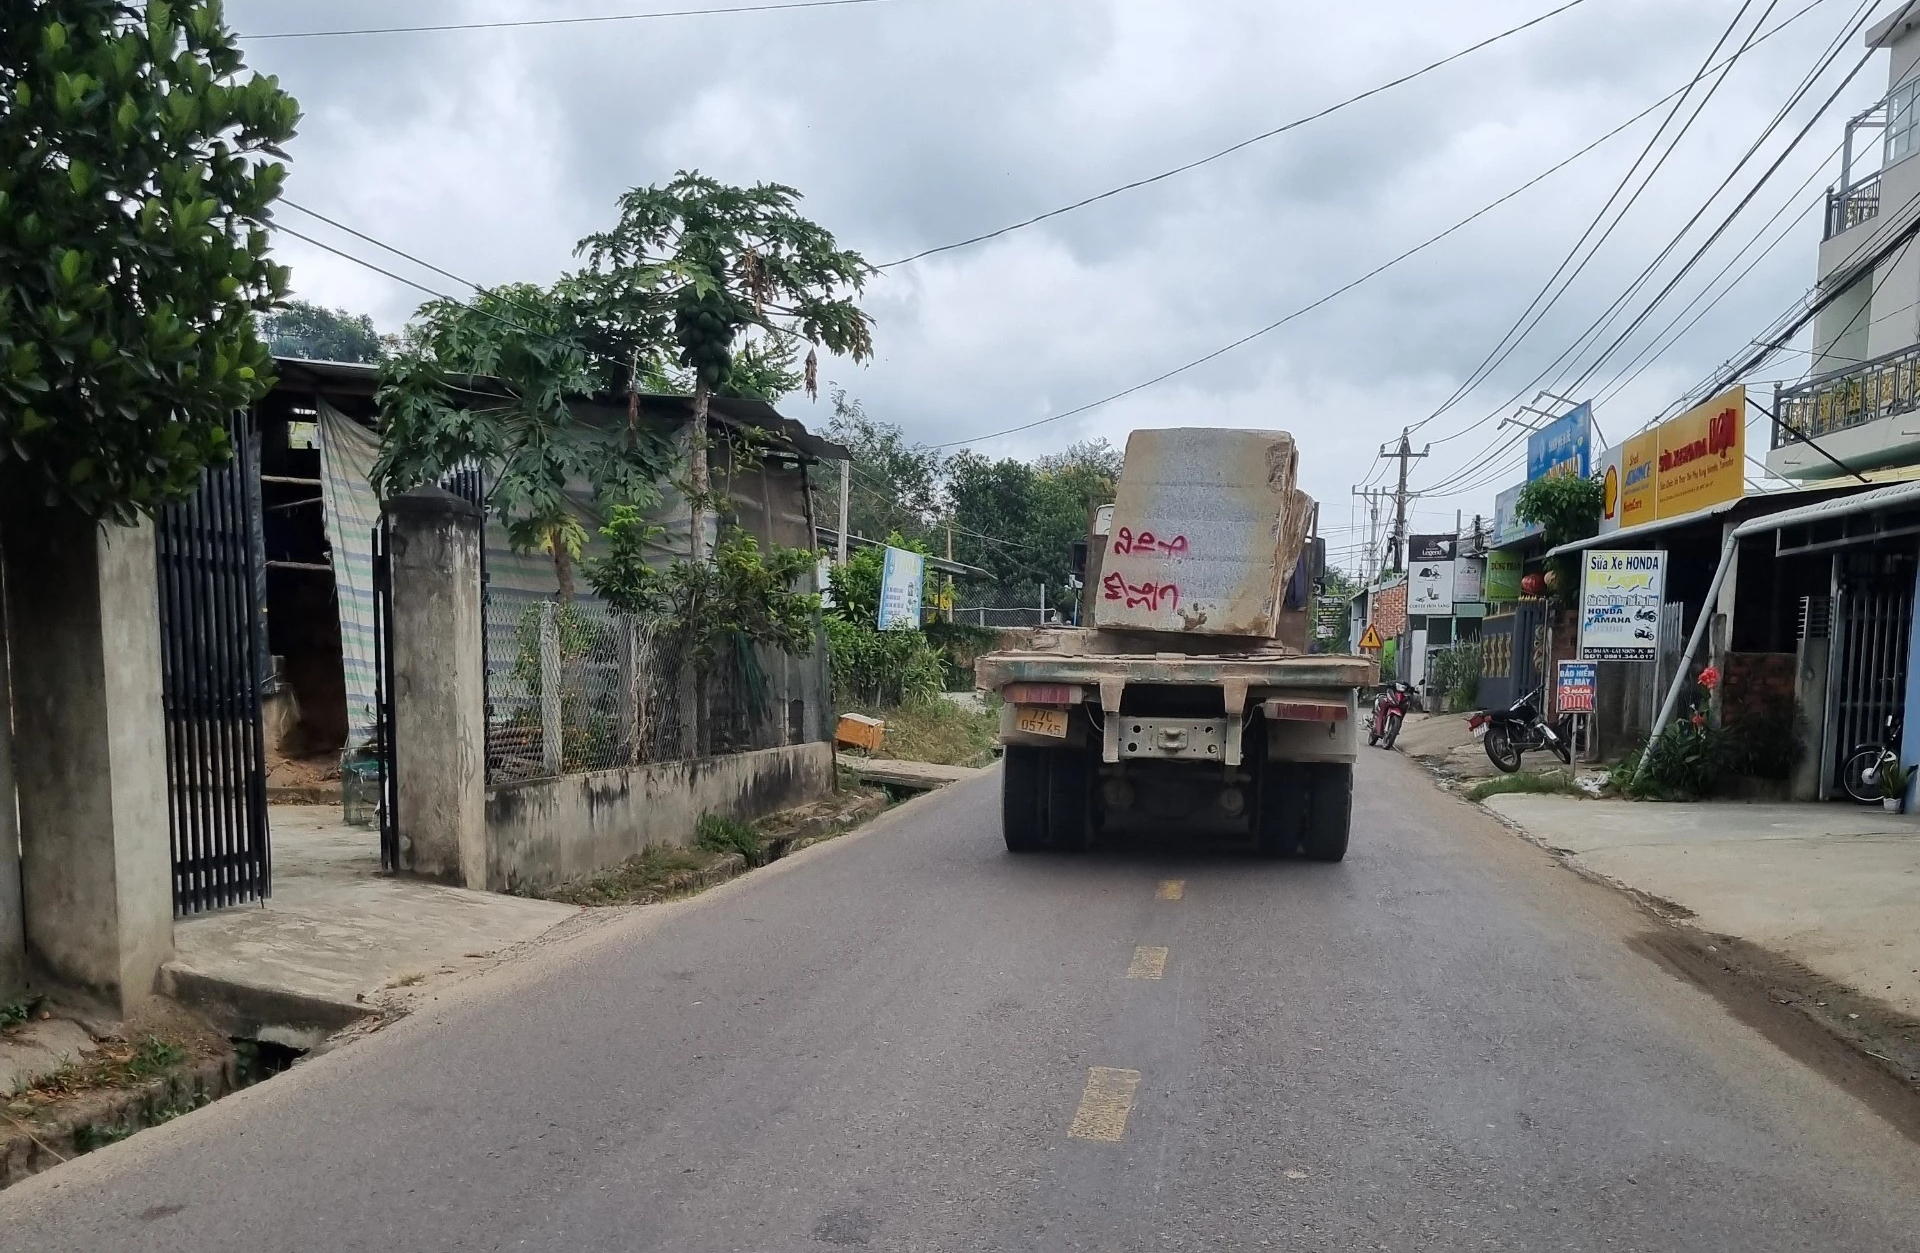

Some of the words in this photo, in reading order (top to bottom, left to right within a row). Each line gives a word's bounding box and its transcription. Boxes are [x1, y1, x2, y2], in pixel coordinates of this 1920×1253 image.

[1591, 555, 1608, 570] Sửa
[1611, 556, 1623, 570] Xe
[1626, 556, 1659, 570] HONDA
[1563, 678, 1573, 686] XE
[1574, 677, 1590, 686] MÁY
[1563, 686, 1570, 694] 3
[1559, 694, 1593, 711] 100K
[1032, 709, 1053, 722] 77C
